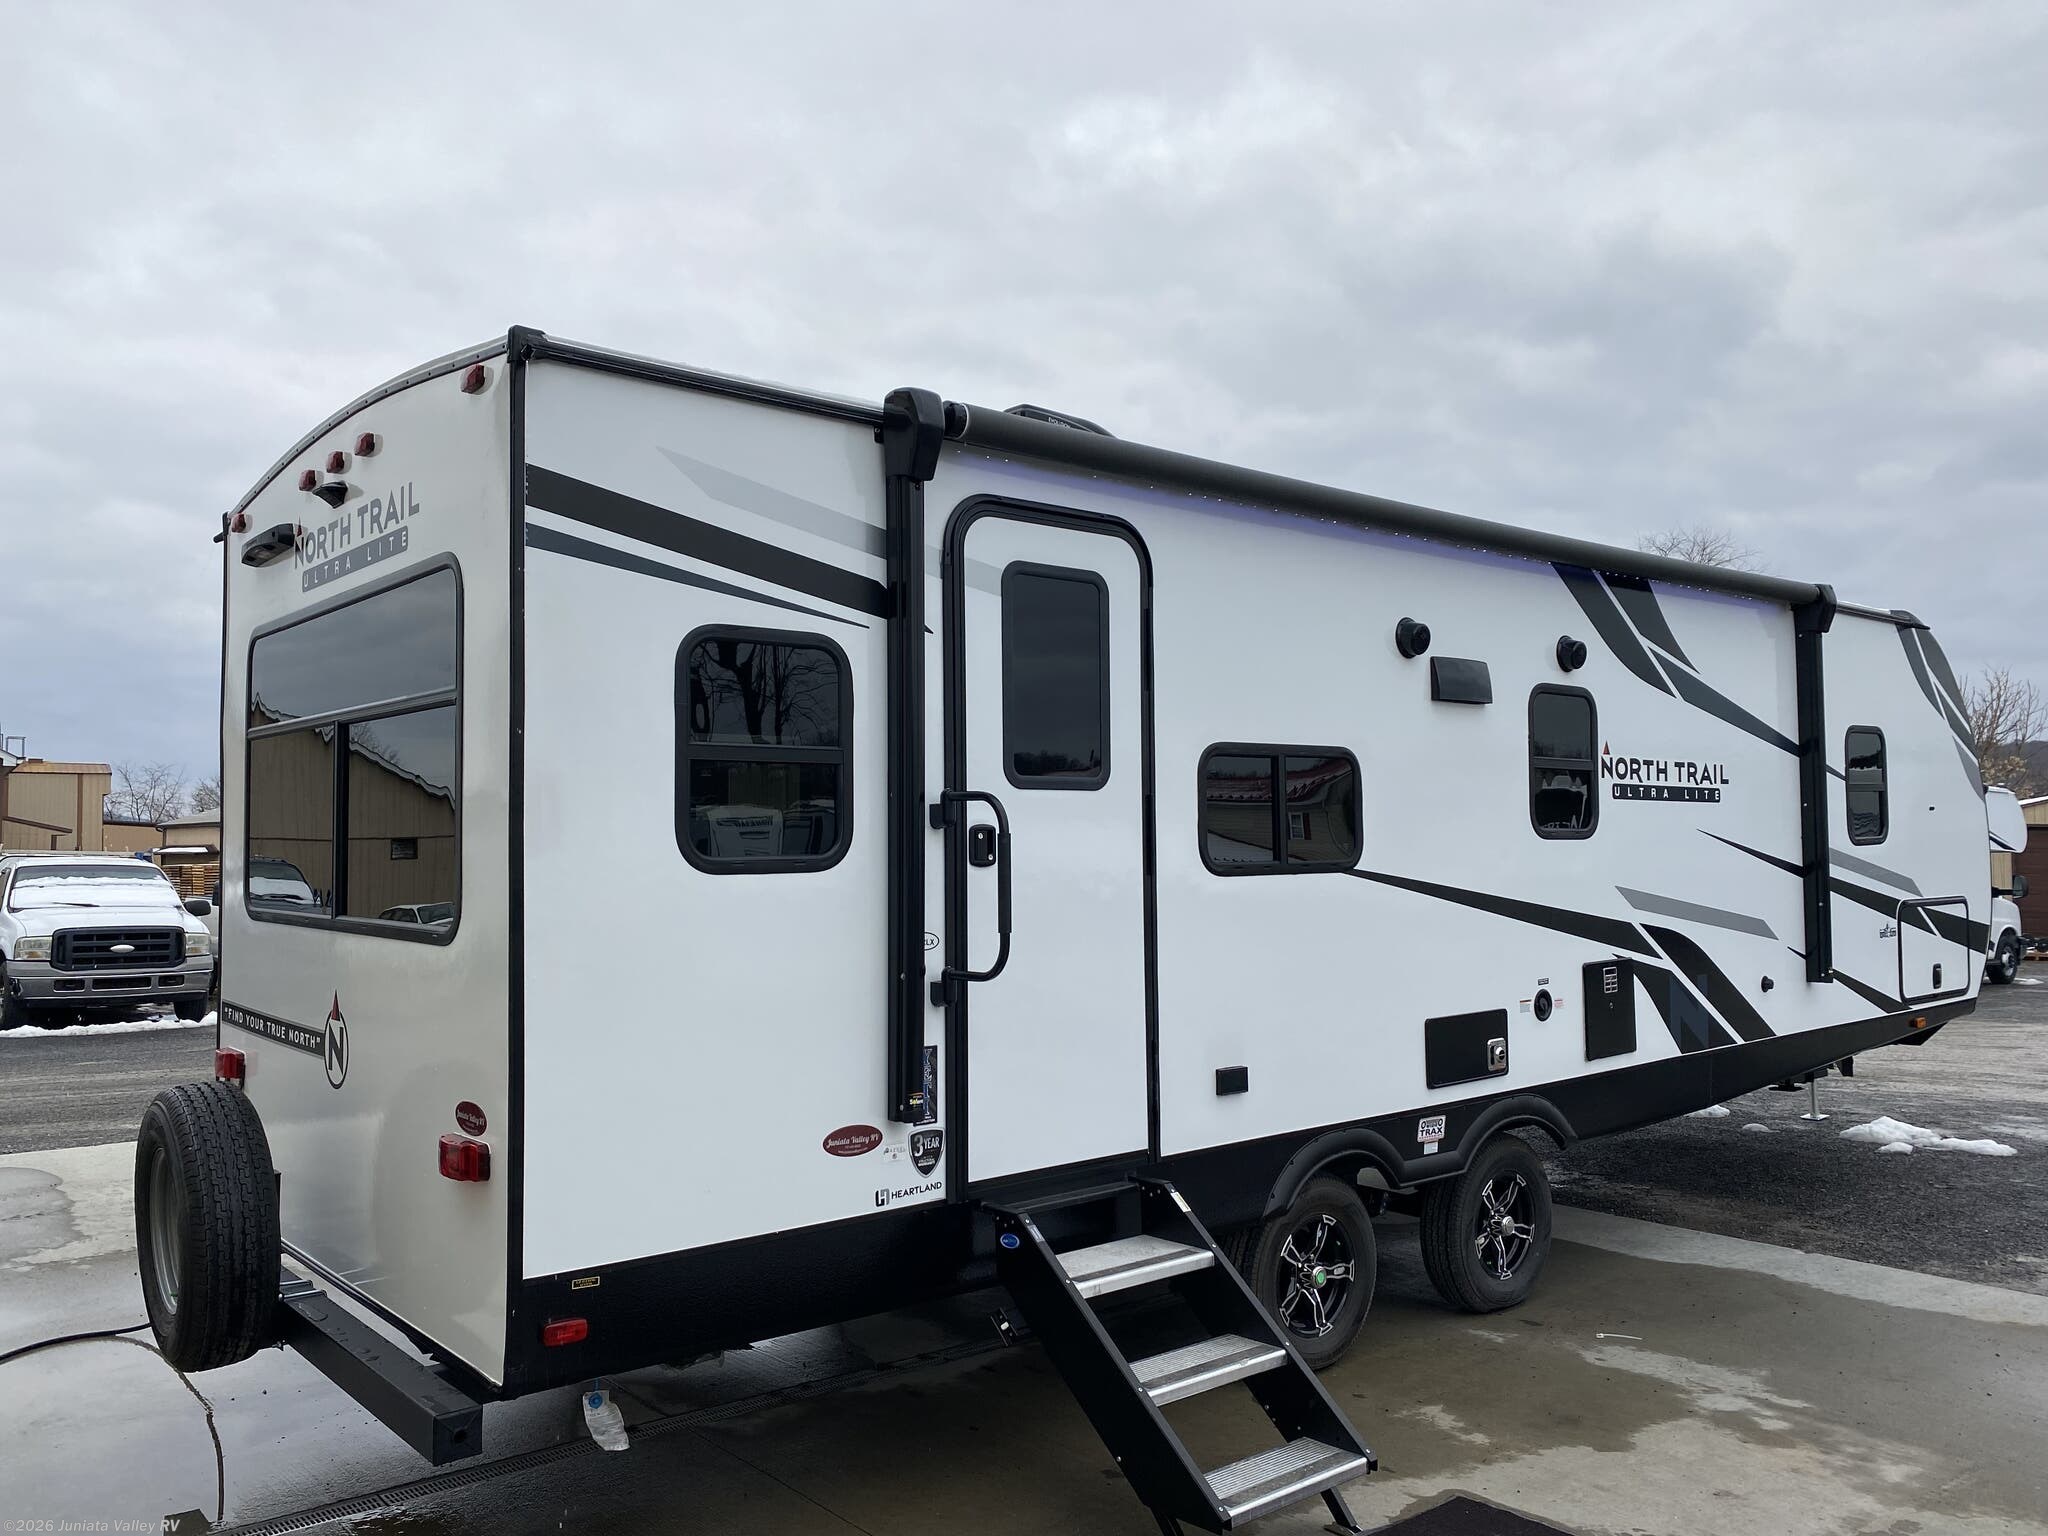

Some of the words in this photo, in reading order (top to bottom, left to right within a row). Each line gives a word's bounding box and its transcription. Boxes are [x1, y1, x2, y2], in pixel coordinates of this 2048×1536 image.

[294, 513, 351, 569] NORTH
[357, 482, 420, 538] TRAIL
[303, 559, 351, 588] ULTRA
[367, 532, 408, 561] LITE
[1601, 756, 1668, 783] NORTH
[1674, 762, 1729, 785] TRAIL
[1614, 786, 1669, 798] ULTRA
[1684, 789, 1720, 800] LITE
[246, 1014, 264, 1031] YOUR
[266, 1021, 286, 1039] TRUE
[851, 1135, 870, 1144] Valley
[1420, 1126, 1442, 1136] TRAX
[914, 1134, 924, 1156] 3
[924, 1137, 940, 1149] YEAR
[891, 1181, 942, 1199] HEARTLAND
